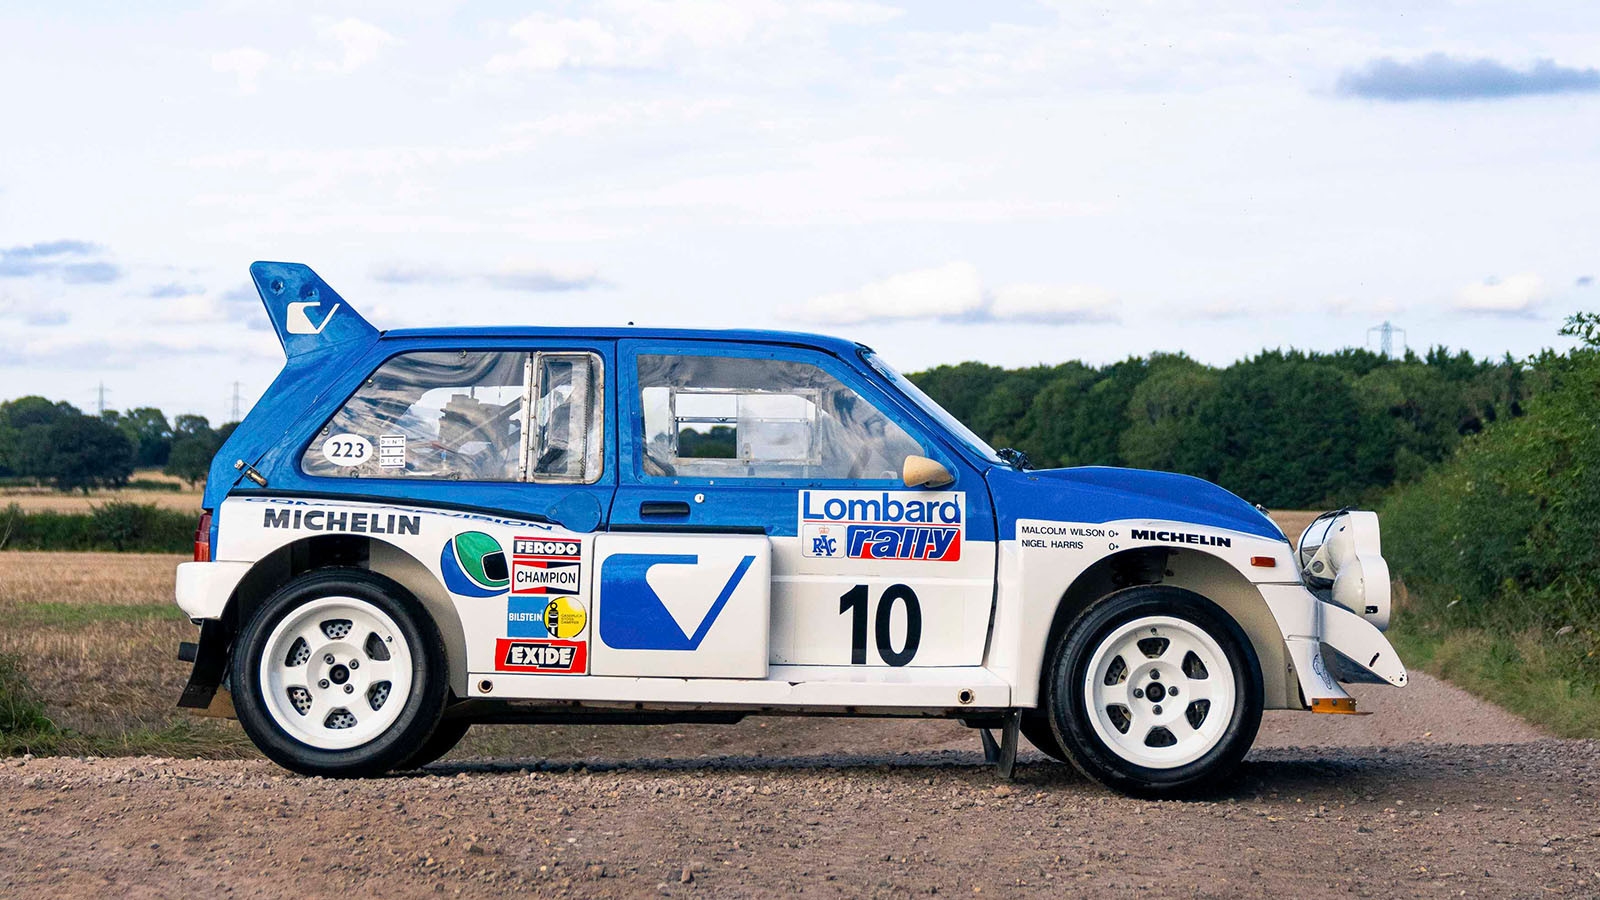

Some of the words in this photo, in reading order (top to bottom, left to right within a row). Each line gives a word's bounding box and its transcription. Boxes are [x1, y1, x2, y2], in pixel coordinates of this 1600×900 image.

[332, 442, 364, 458] 223
[803, 491, 961, 523] Lombard
[264, 508, 420, 535] MICHELIN
[1021, 526, 1067, 535] MALCOLM
[1070, 528, 1105, 537] WILSON
[1131, 529, 1231, 548] MICHELIN
[516, 541, 578, 555] FERODO
[812, 535, 837, 556] RAC
[850, 529, 956, 560] rally
[1021, 539, 1047, 548] NIGEL
[1050, 541, 1084, 549] HARRIS
[516, 571, 576, 584] CHAMPION
[508, 612, 543, 622] BILSTEIN
[839, 583, 922, 667] 10
[511, 646, 572, 665] EXIDE
